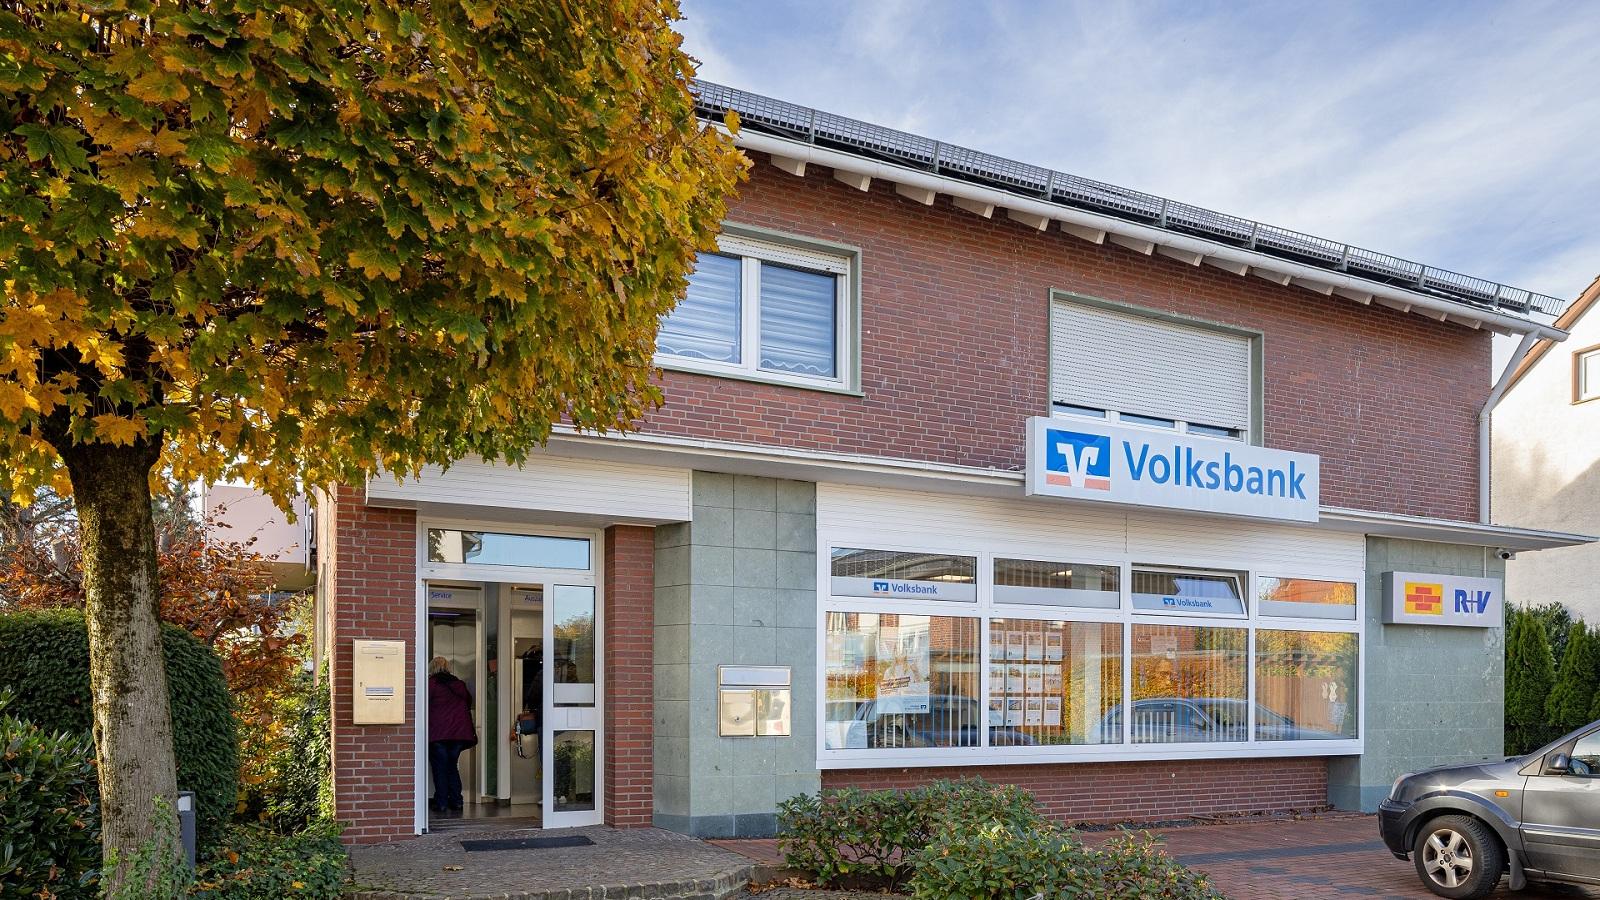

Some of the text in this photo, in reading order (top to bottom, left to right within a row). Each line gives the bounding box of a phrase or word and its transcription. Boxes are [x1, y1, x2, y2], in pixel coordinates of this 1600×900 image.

[1122, 440, 1307, 500] Volksbank
[891, 583, 938, 595] Volksbank
[431, 591, 452, 600] Service
[1454, 589, 1491, 614] R+V
[1175, 598, 1213, 608] Volksbank
